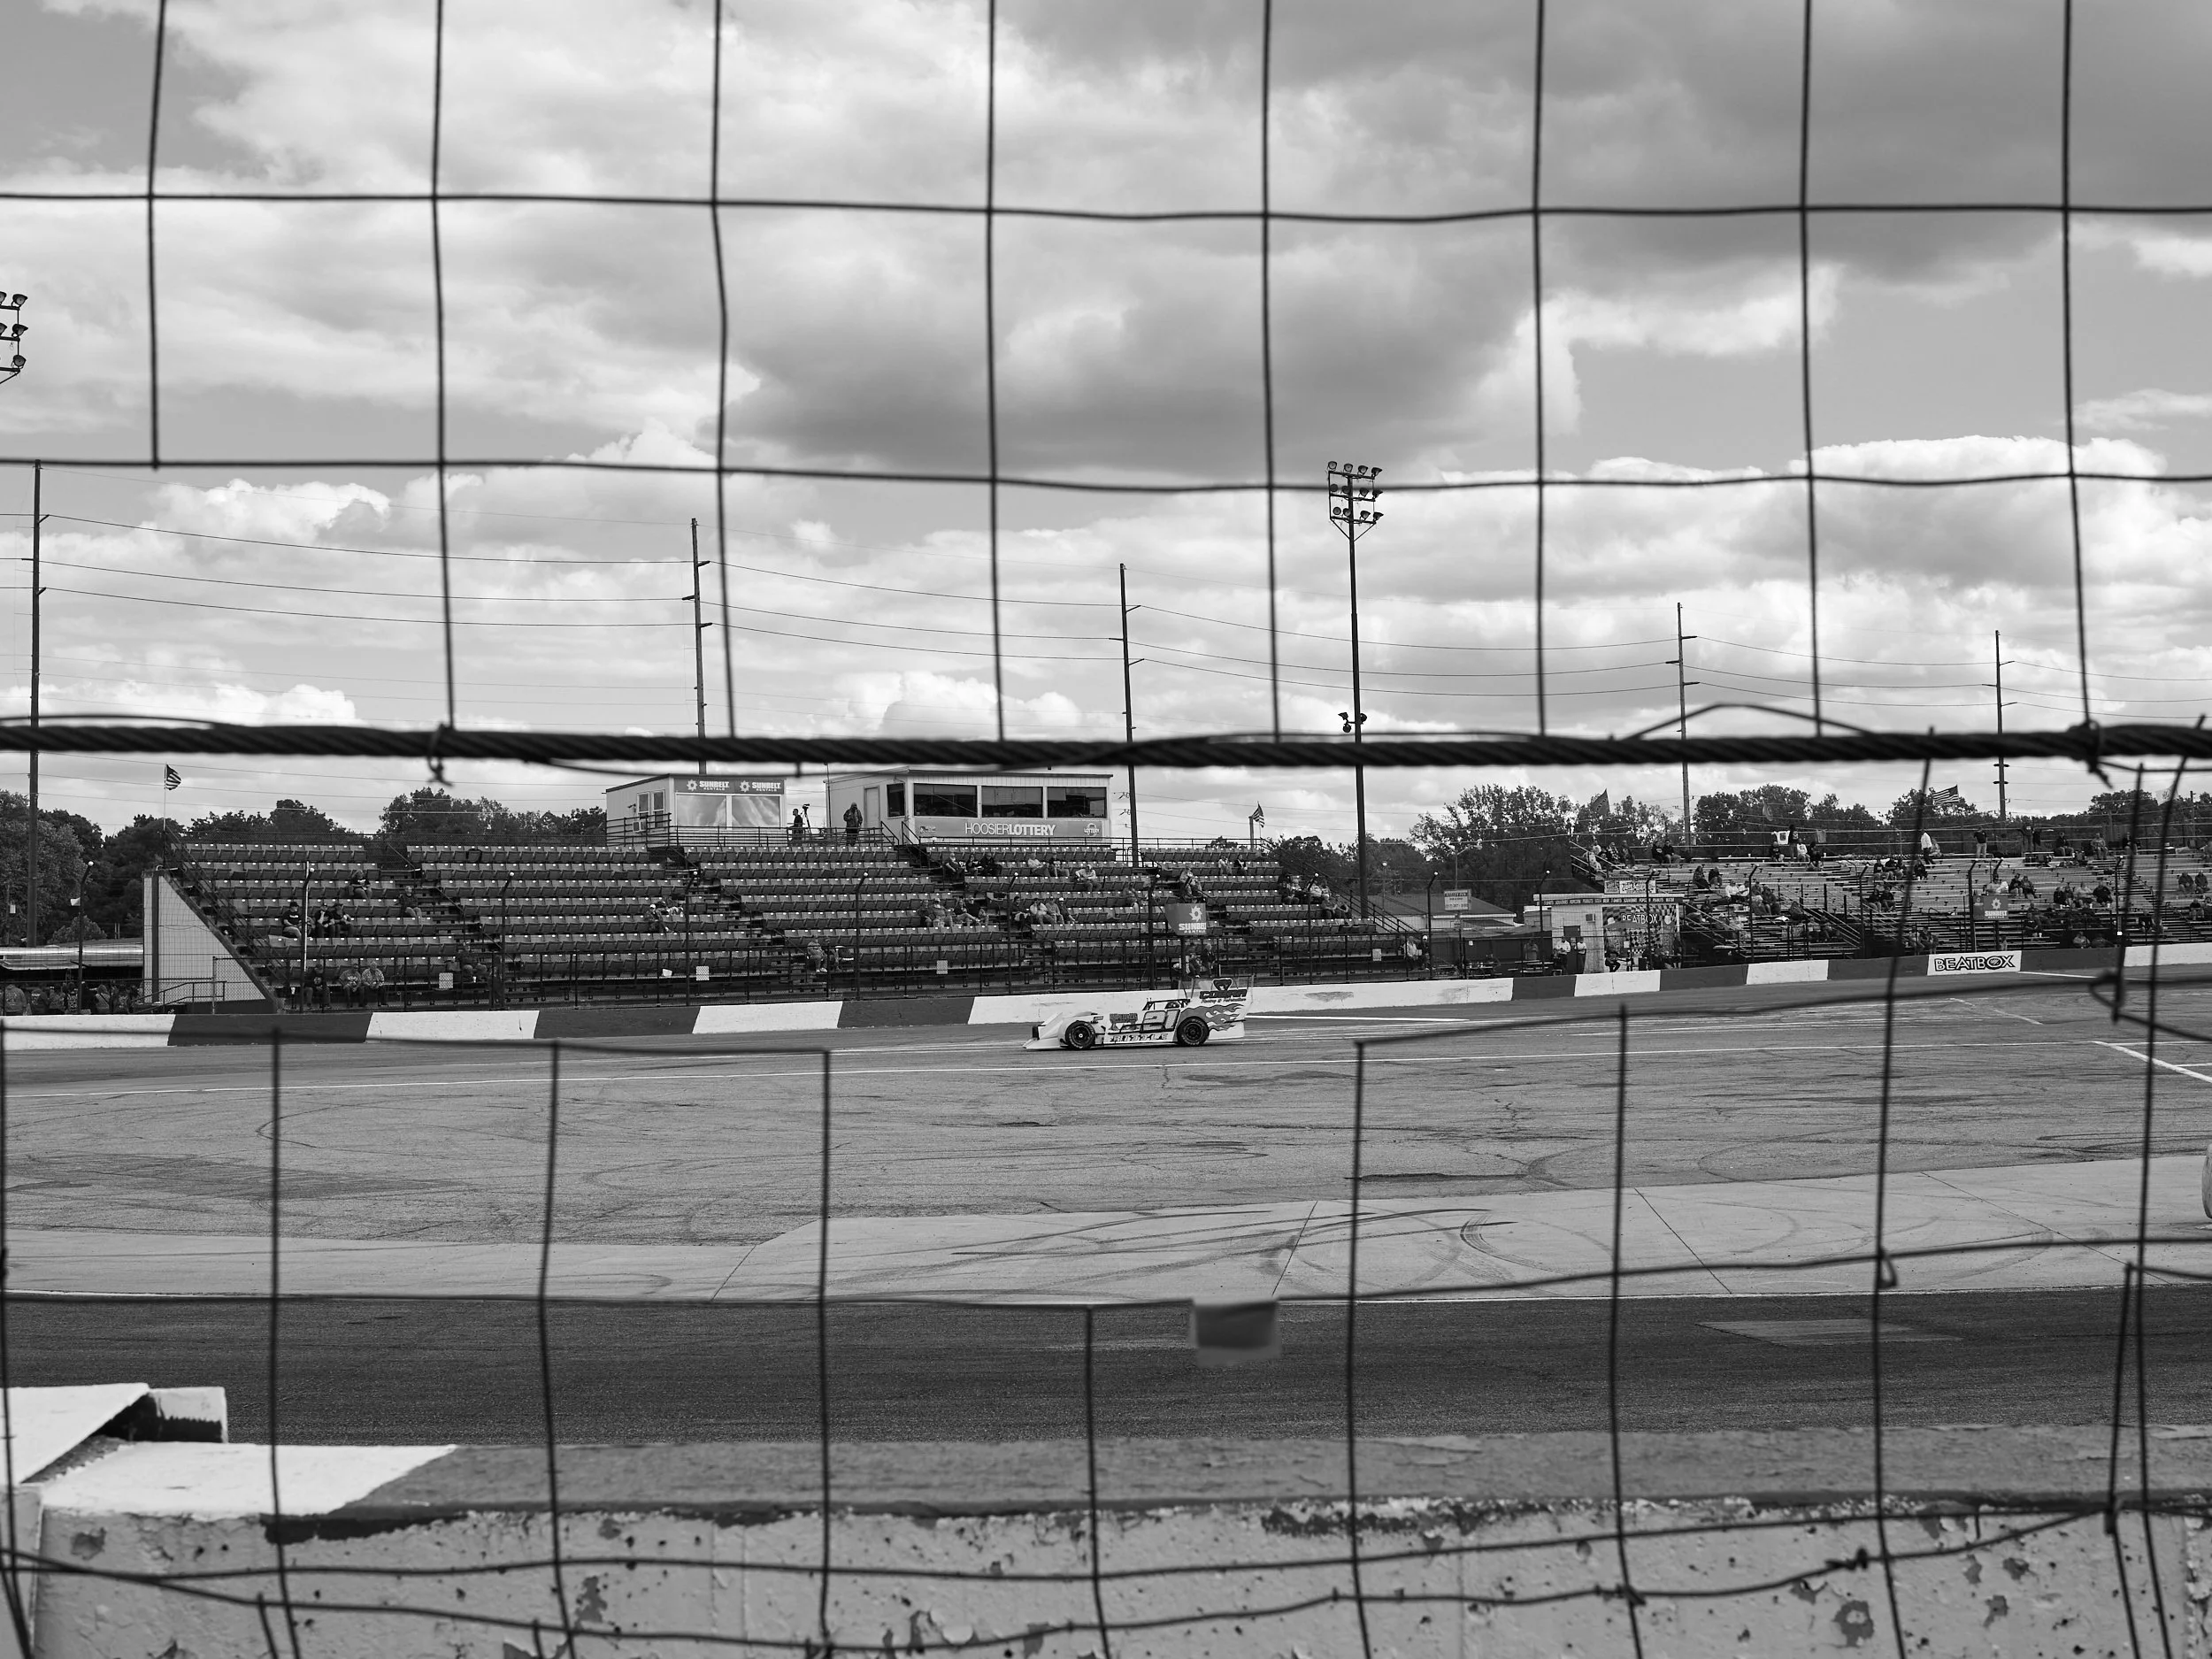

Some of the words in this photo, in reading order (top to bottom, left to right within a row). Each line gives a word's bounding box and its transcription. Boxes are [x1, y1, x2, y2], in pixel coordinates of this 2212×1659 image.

[1622, 913, 1658, 925] BEATBOX
[1934, 956, 2016, 972] BEATBOX
[1139, 1009, 1180, 1033] 21
